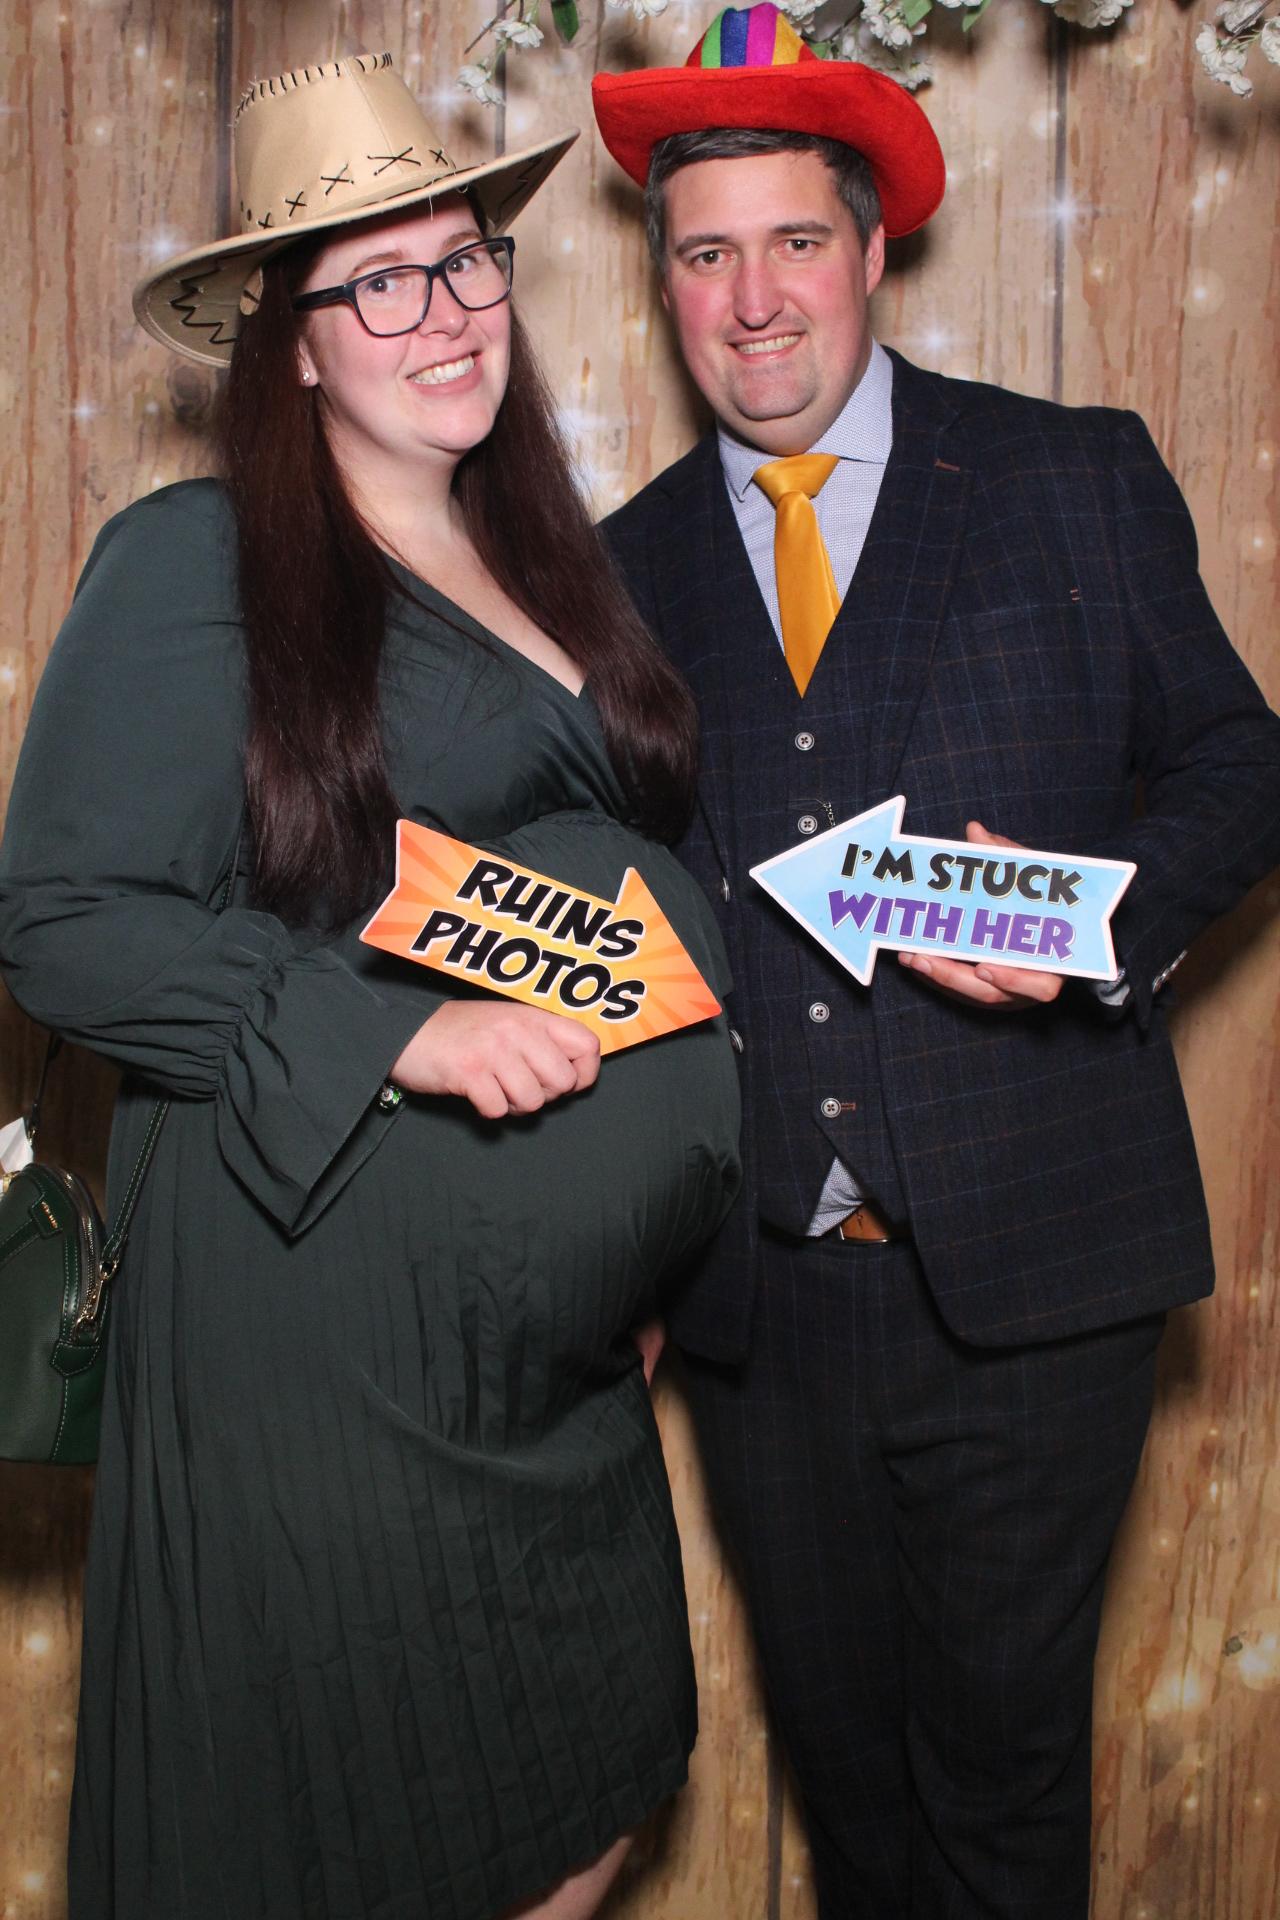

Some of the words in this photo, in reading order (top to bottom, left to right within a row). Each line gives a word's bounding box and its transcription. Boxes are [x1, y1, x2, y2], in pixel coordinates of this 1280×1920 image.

[456, 859, 645, 958] RUINS
[840, 843, 914, 884] I'M
[927, 853, 1082, 905] STUCK
[411, 910, 646, 1020] PHOTOS
[828, 890, 965, 945] WITH
[970, 908, 1075, 961] HER
